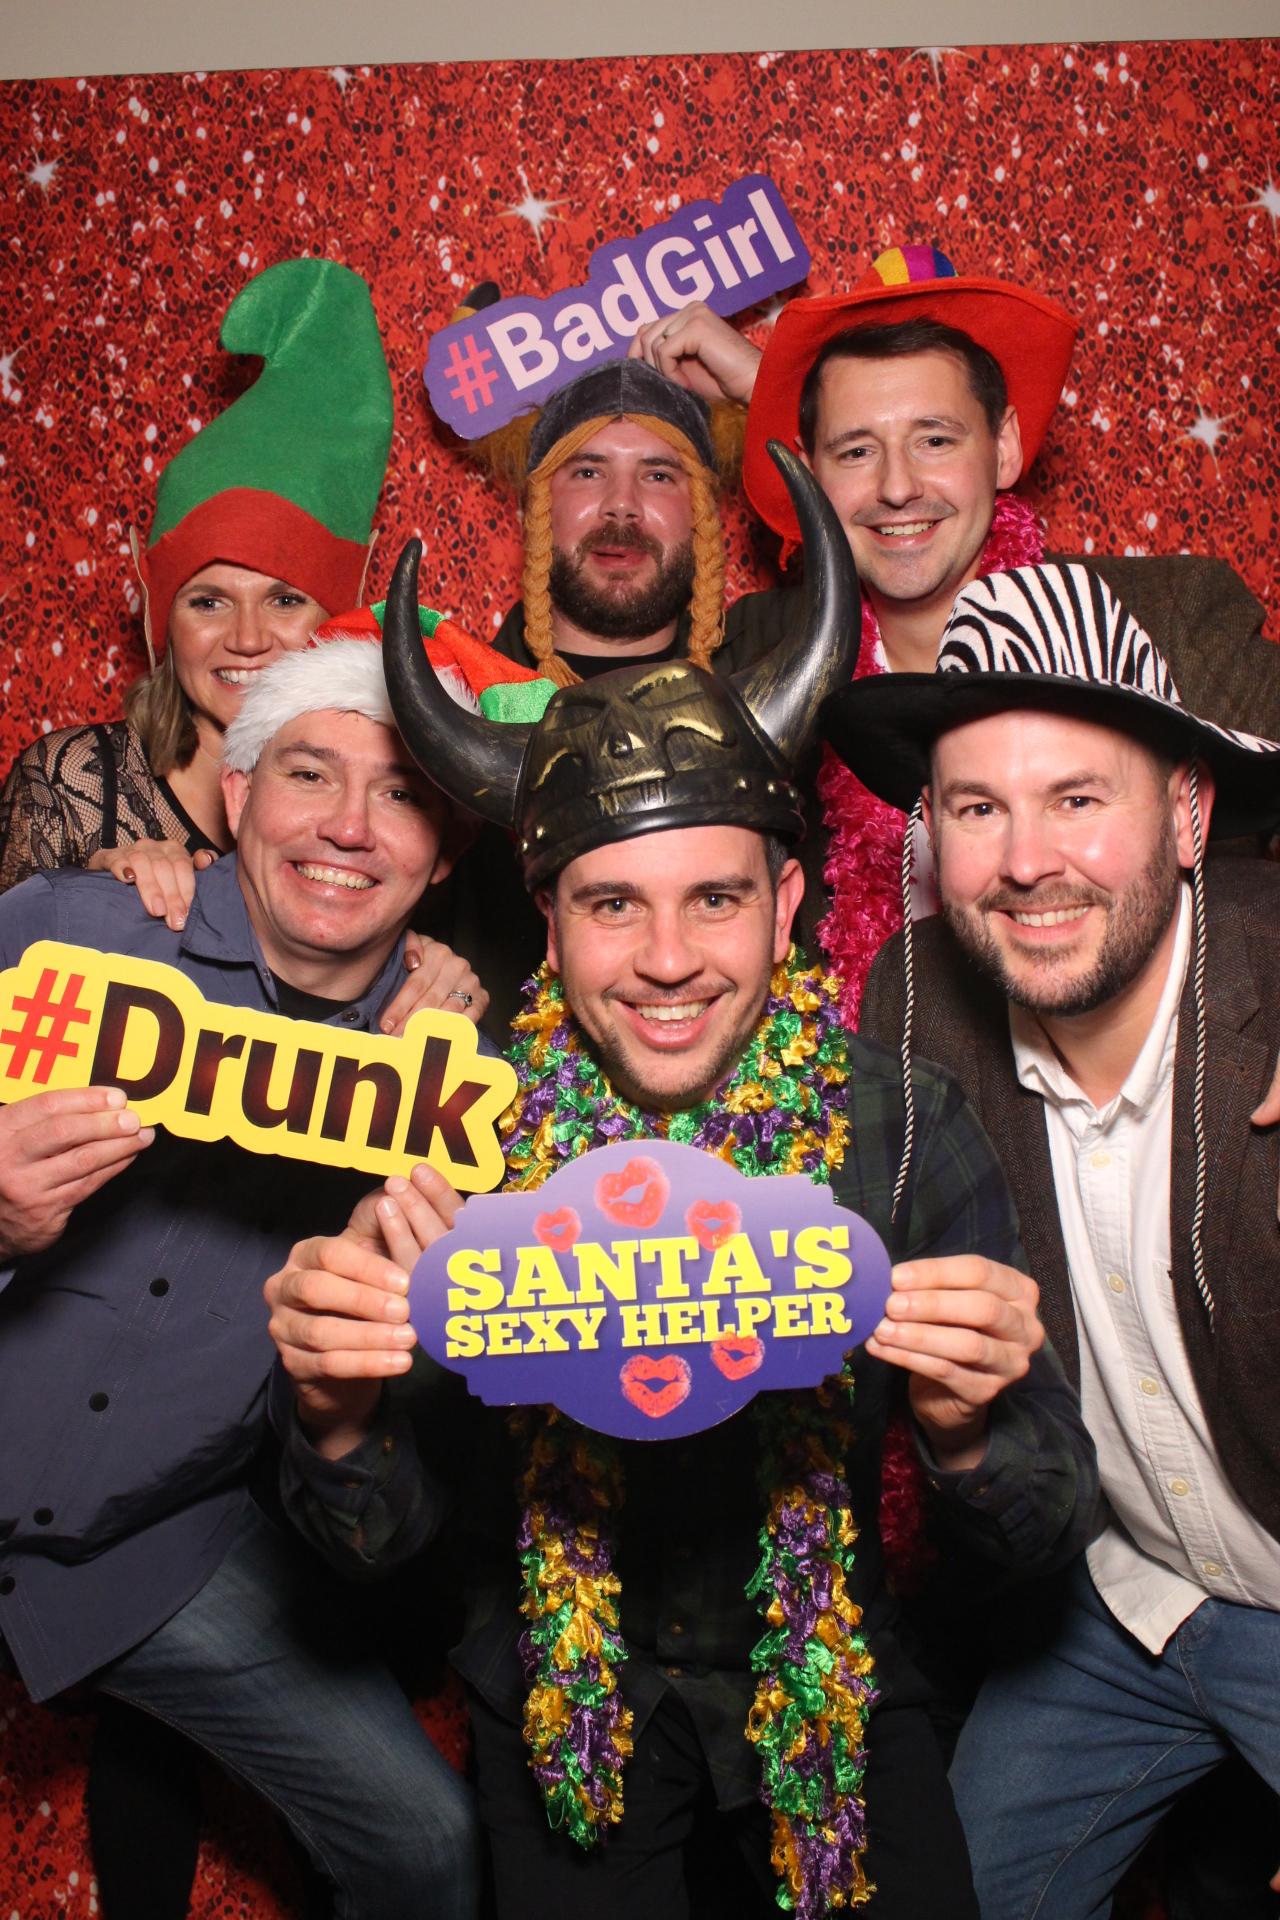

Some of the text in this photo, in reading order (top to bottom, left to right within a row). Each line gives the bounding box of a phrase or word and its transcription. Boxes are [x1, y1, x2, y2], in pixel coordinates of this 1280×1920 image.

[444, 188, 796, 415] #BadGirl
[0, 967, 491, 1168] #Drunk
[445, 1226, 853, 1312] SANTA'S
[445, 1292, 853, 1358] SEXY HELPER
